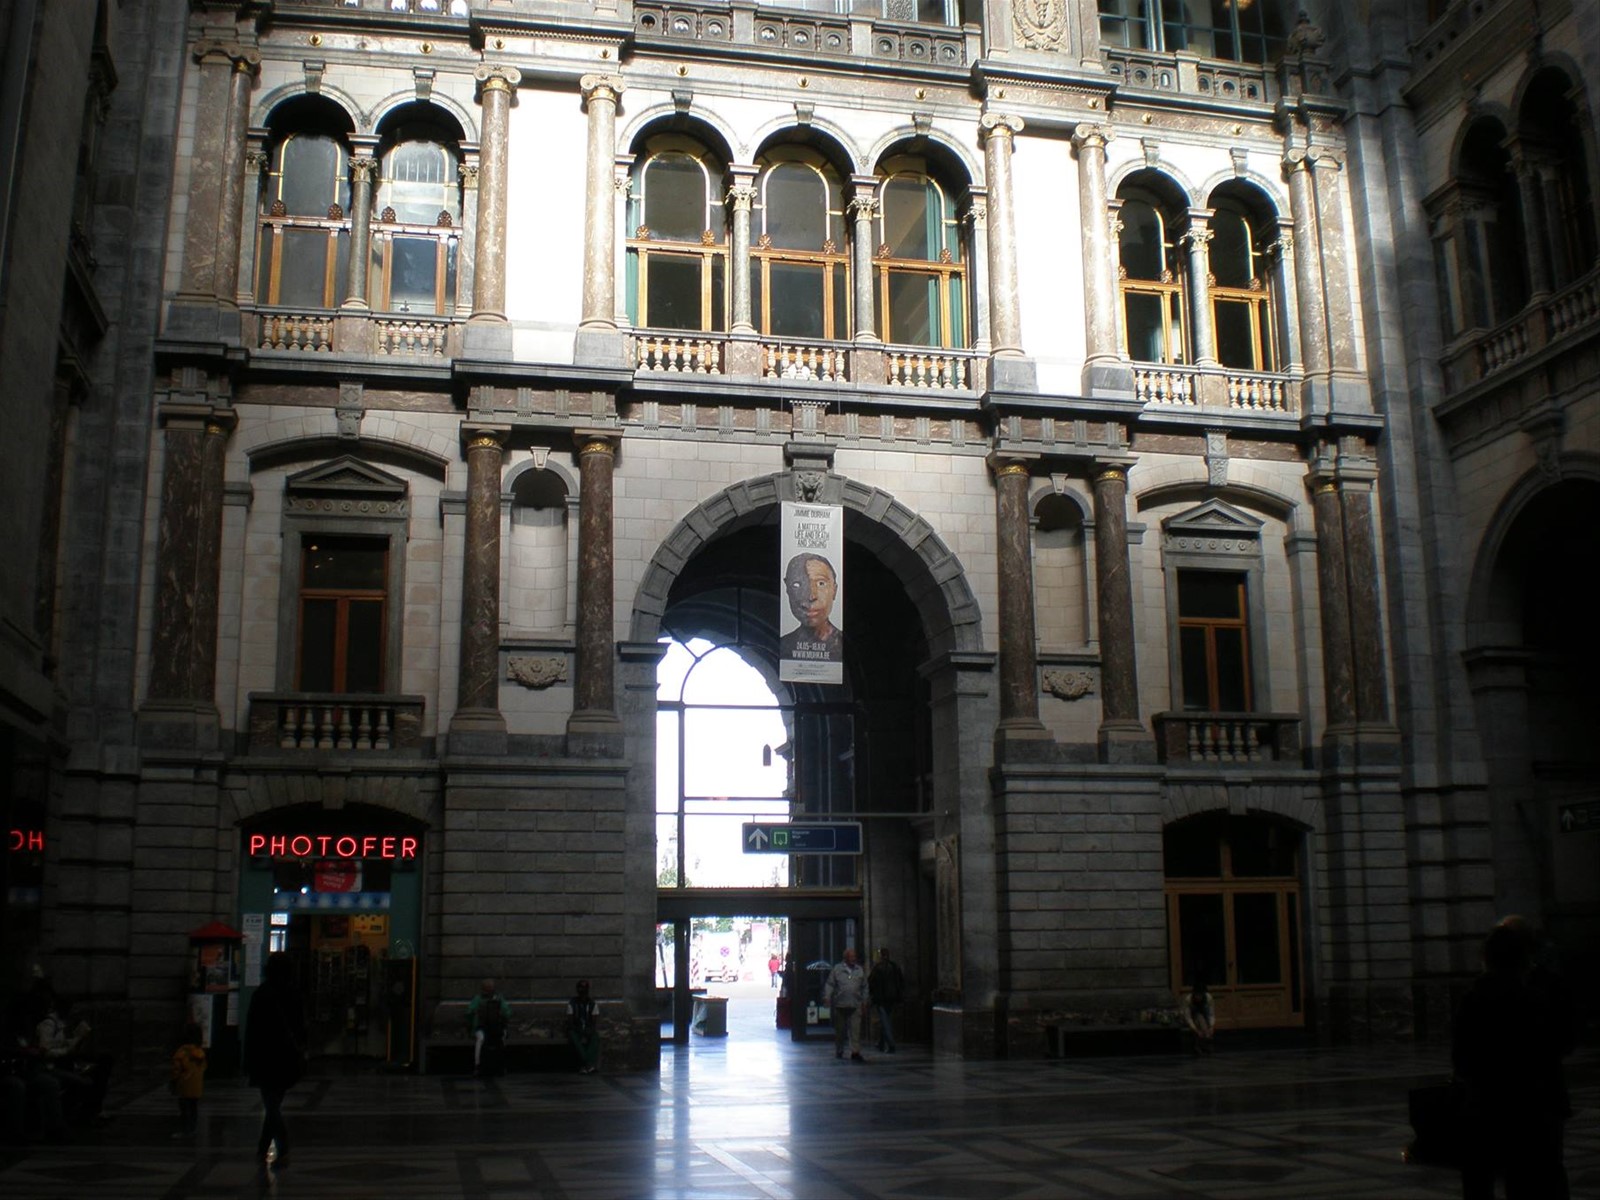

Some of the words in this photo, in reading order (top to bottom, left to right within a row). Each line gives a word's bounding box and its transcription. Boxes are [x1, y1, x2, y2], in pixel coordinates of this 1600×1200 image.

[805, 531, 815, 540] AND
[797, 539, 807, 548] AND
[249, 834, 419, 858] PHOTOFER
